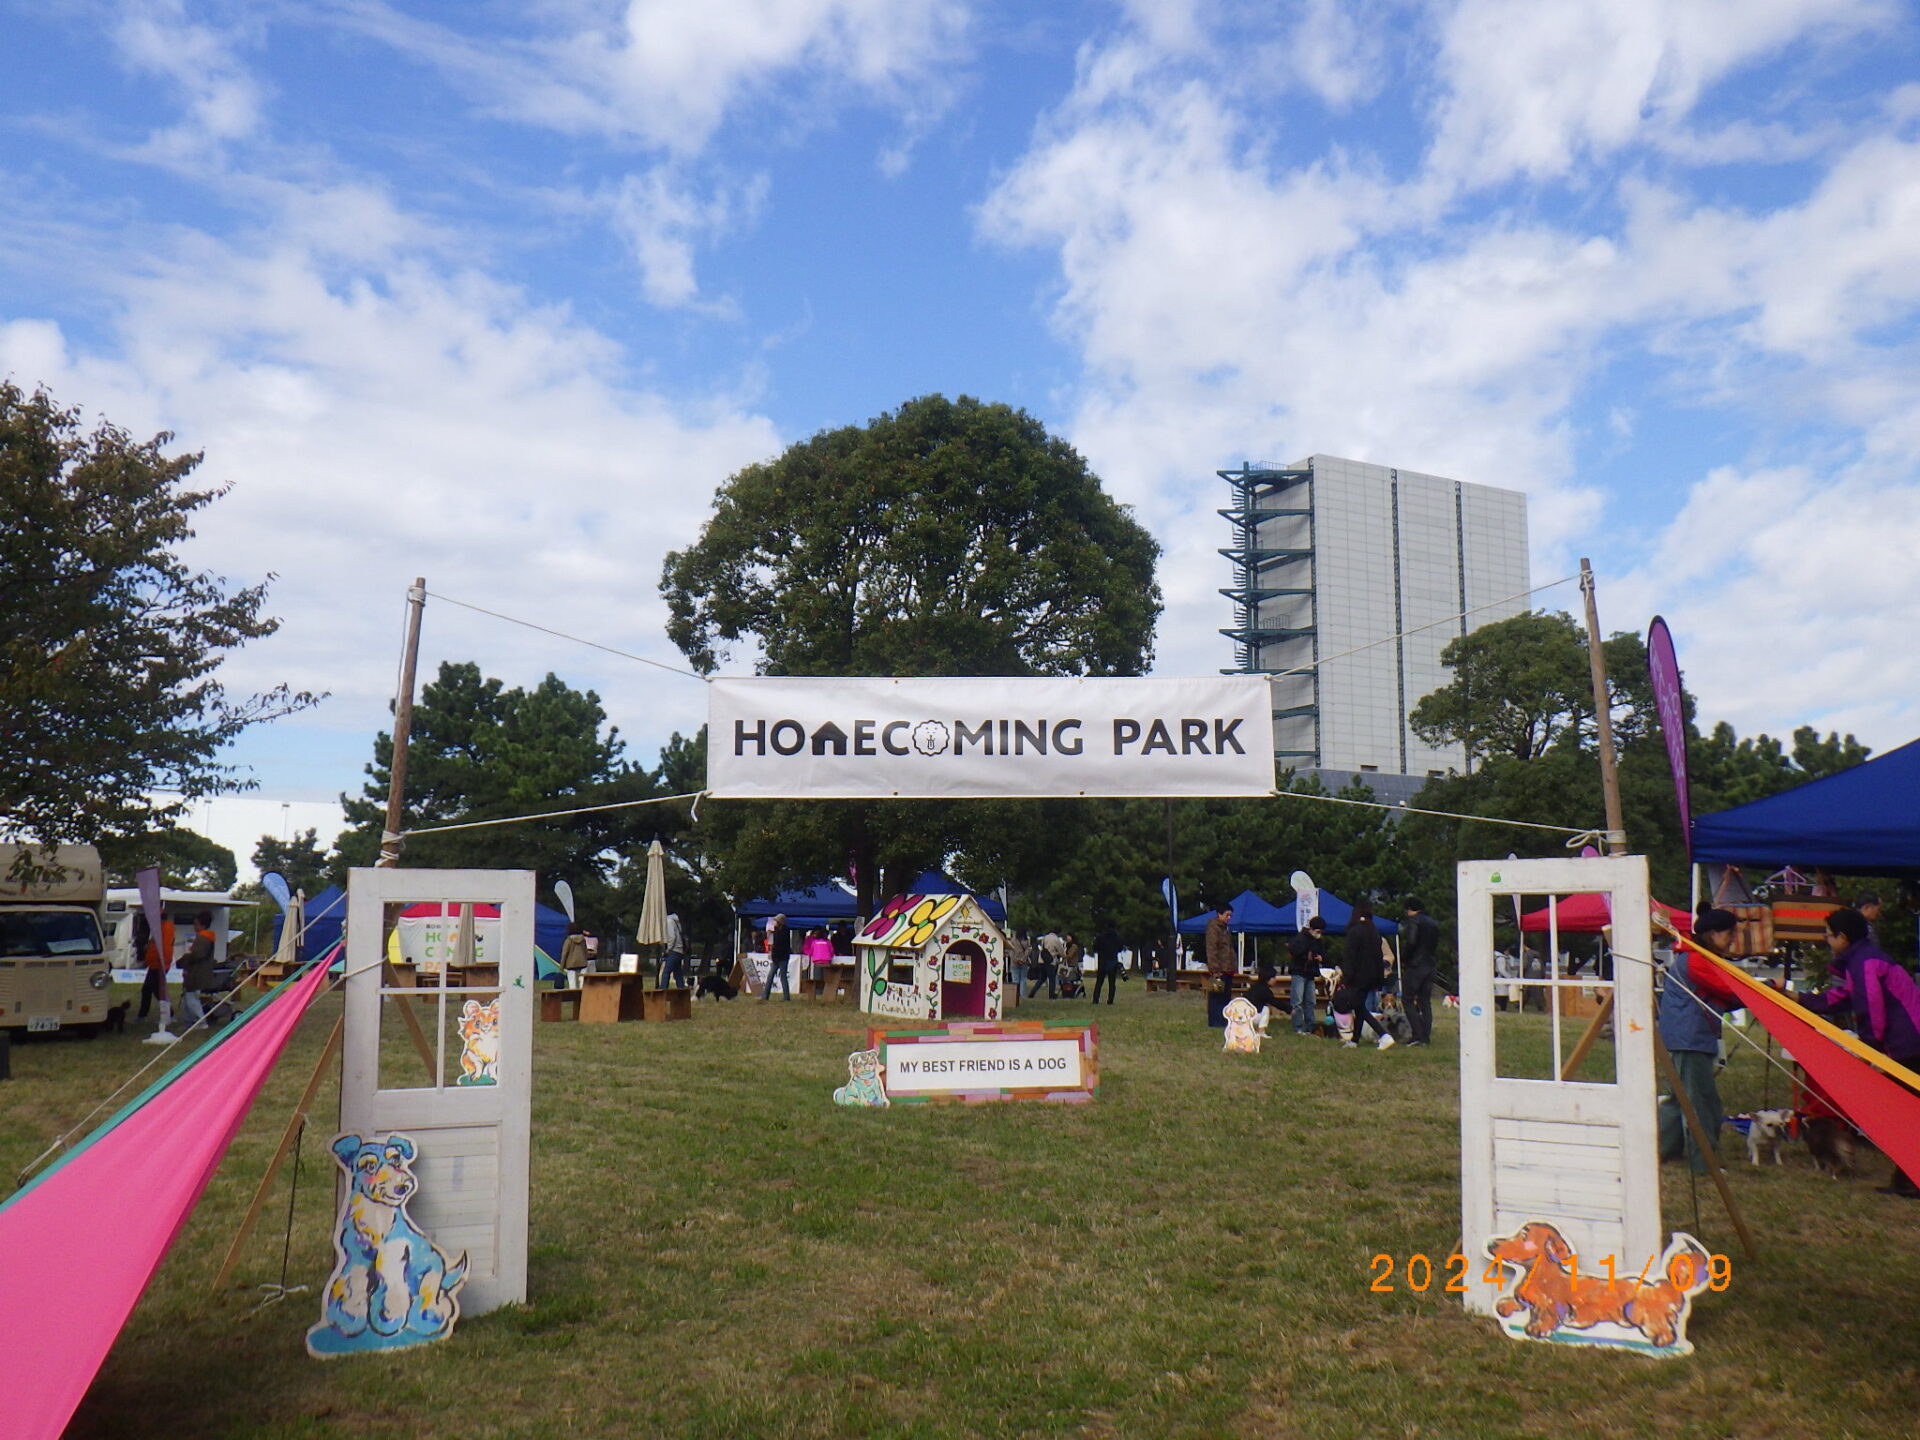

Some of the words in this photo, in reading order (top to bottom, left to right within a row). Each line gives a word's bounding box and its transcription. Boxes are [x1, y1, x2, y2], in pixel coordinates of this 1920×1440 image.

[1113, 718, 1247, 756] PARK
[900, 1060, 919, 1073] MY
[922, 1060, 956, 1073] BEST
[959, 1058, 1005, 1072] FRIEND
[1009, 1058, 1020, 1071] IS
[1024, 1058, 1033, 1071] A
[1038, 1057, 1066, 1070] DOG
